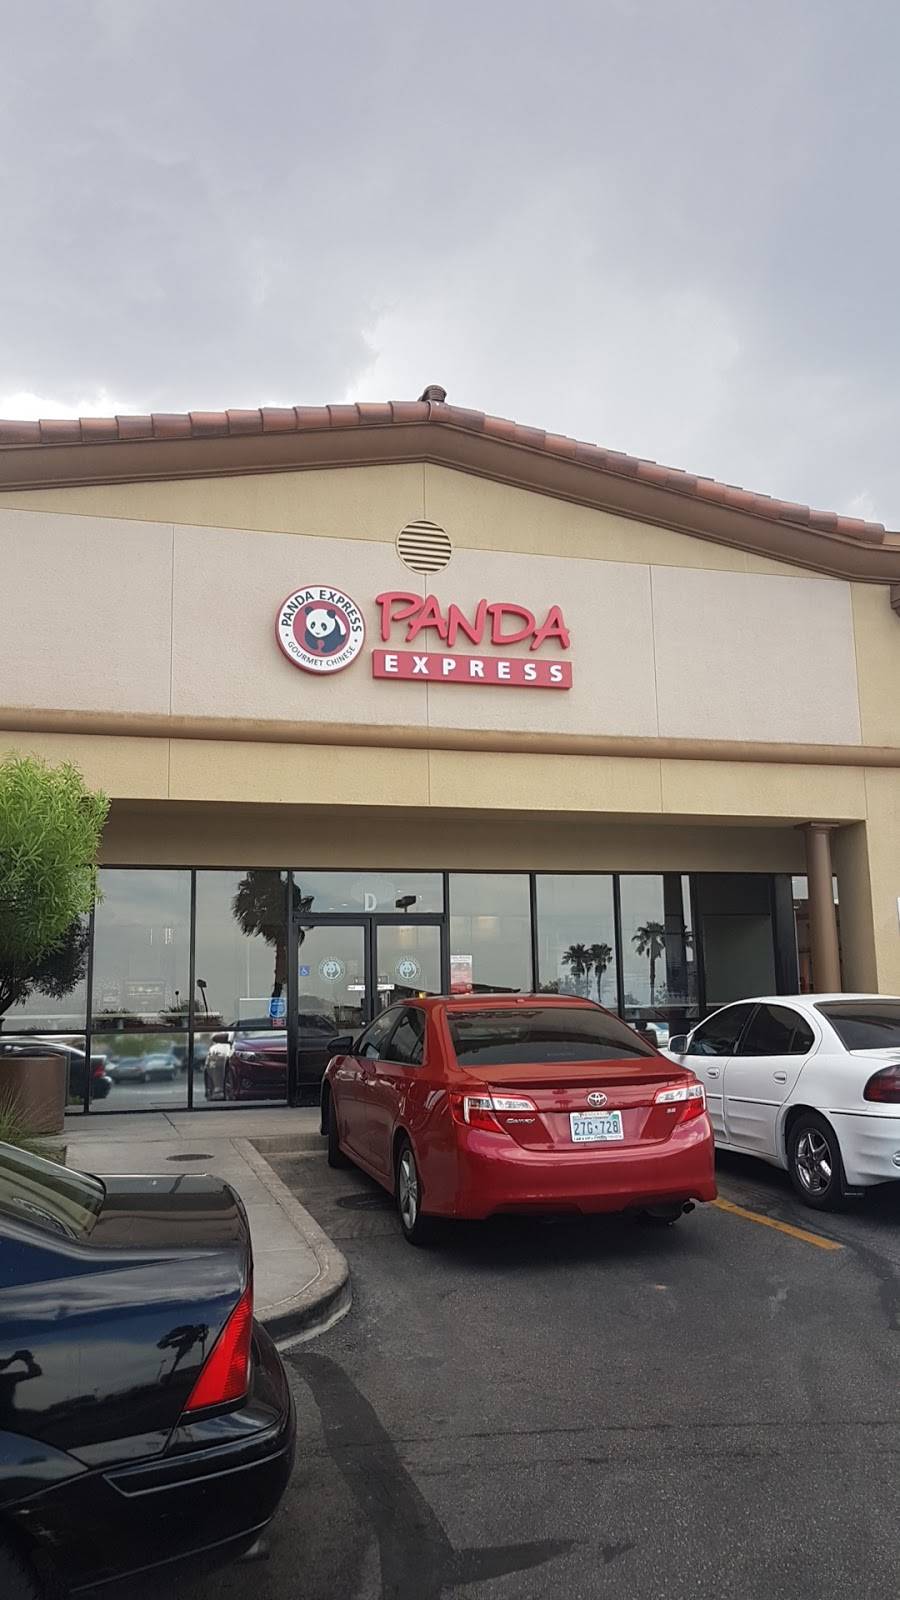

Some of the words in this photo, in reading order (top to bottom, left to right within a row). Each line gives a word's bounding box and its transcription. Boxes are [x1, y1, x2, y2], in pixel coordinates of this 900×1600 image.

[281, 591, 315, 627] PANDA
[319, 589, 362, 633] EXPRESS
[375, 591, 571, 652] PANDA
[287, 641, 324, 667] GOURMET
[325, 645, 356, 667] CHINESE
[384, 654, 563, 682] EXPRESS
[364, 893, 377, 912] D
